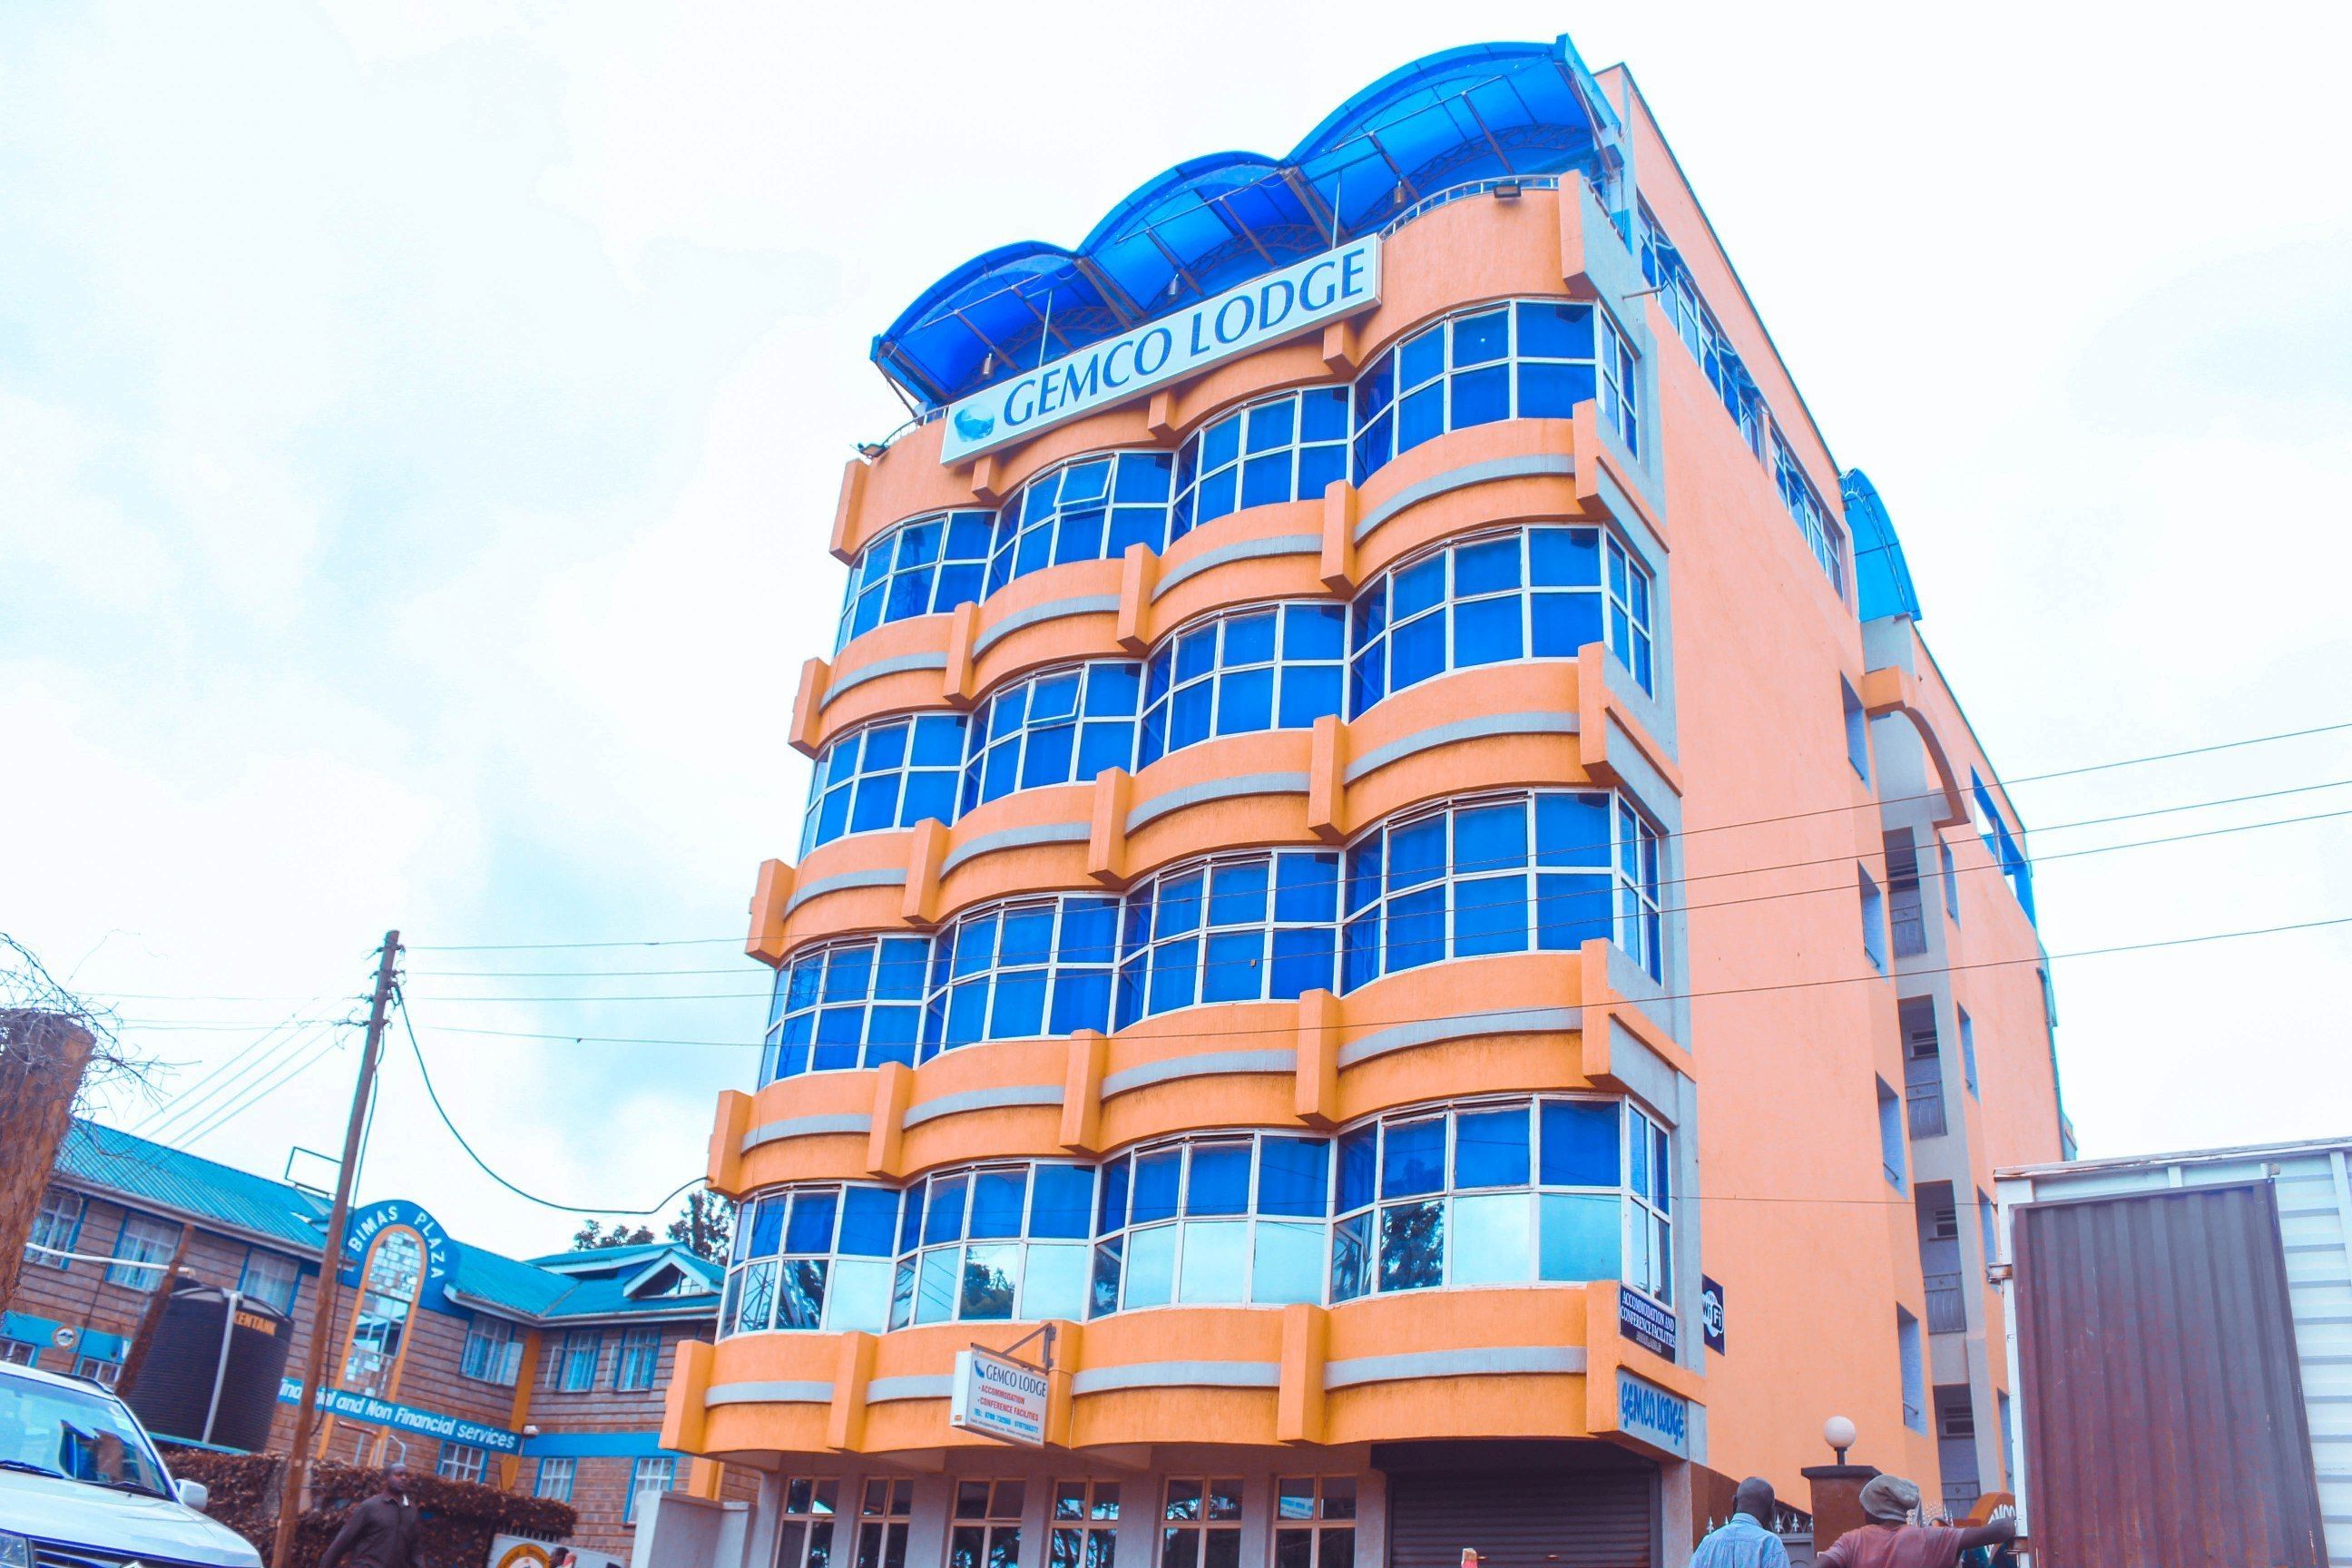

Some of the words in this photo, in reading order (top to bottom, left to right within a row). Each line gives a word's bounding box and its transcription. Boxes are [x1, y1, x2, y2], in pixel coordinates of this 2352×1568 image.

[1004, 327, 1172, 427] GEMCO
[1190, 247, 1366, 358] LODGE
[348, 1205, 398, 1252] BIMAS
[414, 1211, 446, 1279] PLAZA
[1621, 1305, 1651, 1336] CONFERENCE
[1651, 1323, 1676, 1348] FACILITIES
[1622, 1289, 1665, 1325] ACCOMMODATION
[1664, 1314, 1675, 1332] AND
[981, 1385, 1024, 1405] ACCOMMODATION
[985, 1364, 1017, 1387] GEMCO
[1019, 1375, 1046, 1397] LODGE
[336, 1397, 366, 1414] and
[365, 1400, 393, 1421] Non
[394, 1406, 456, 1436] Financial
[456, 1424, 515, 1449] services
[980, 1397, 1013, 1414] CONFERENCE
[1014, 1406, 1039, 1422] FACILITIES
